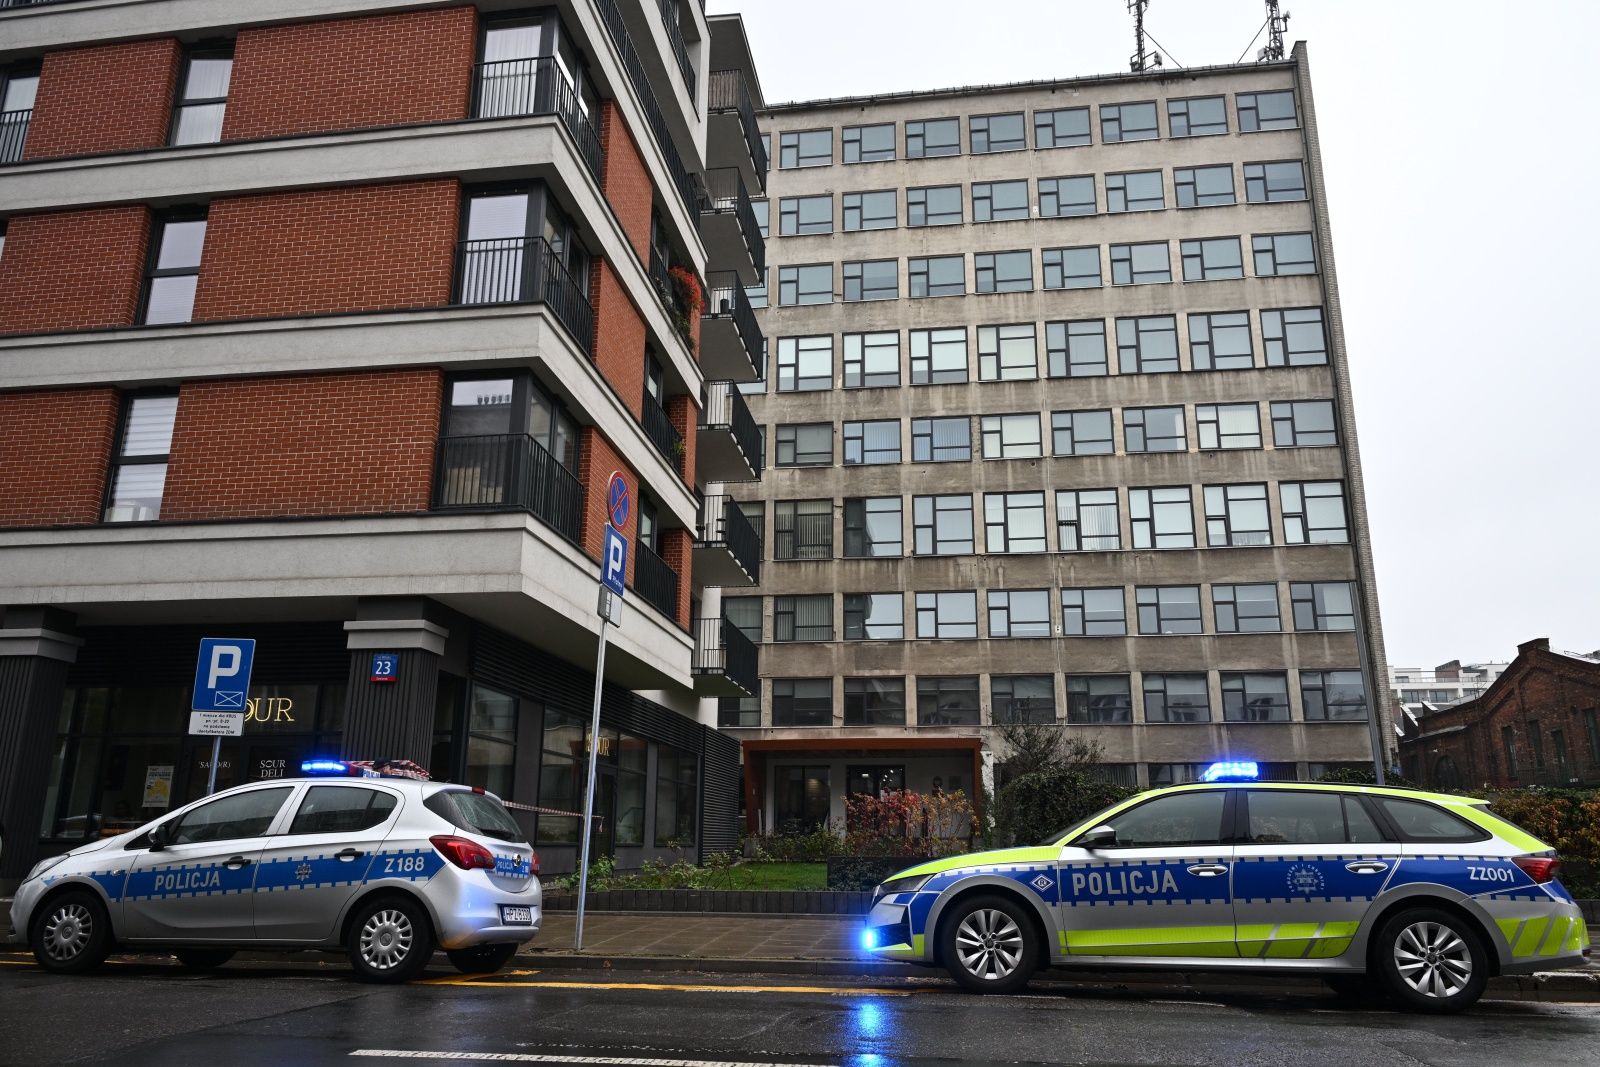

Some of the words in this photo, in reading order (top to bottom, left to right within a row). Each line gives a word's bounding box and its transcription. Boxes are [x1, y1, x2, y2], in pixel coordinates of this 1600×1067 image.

[608, 534, 623, 580] P
[207, 645, 242, 689] P
[375, 661, 391, 675] 23
[259, 759, 286, 768] SOUR
[260, 768, 284, 778] DELI
[384, 856, 424, 873] Z188
[154, 870, 221, 891] POLICJA
[1071, 869, 1179, 896] POLICJA
[1466, 866, 1515, 883] ZZ001
